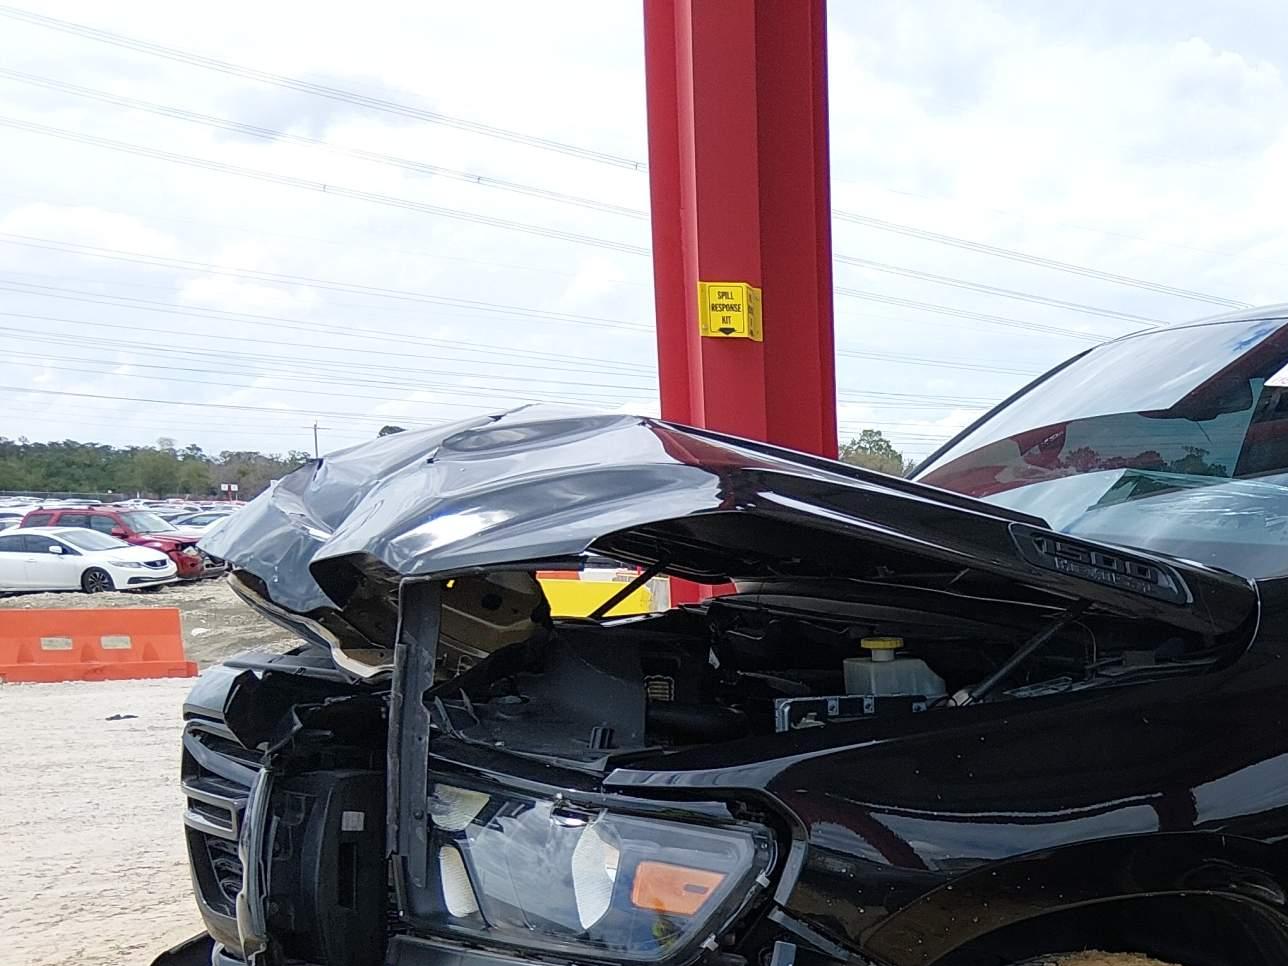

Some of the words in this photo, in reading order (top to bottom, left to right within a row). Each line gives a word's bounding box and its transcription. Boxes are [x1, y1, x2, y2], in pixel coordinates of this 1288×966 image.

[717, 291, 734, 300] SPILL
[711, 303, 741, 312] RESPONSE
[721, 315, 732, 325] KIT
